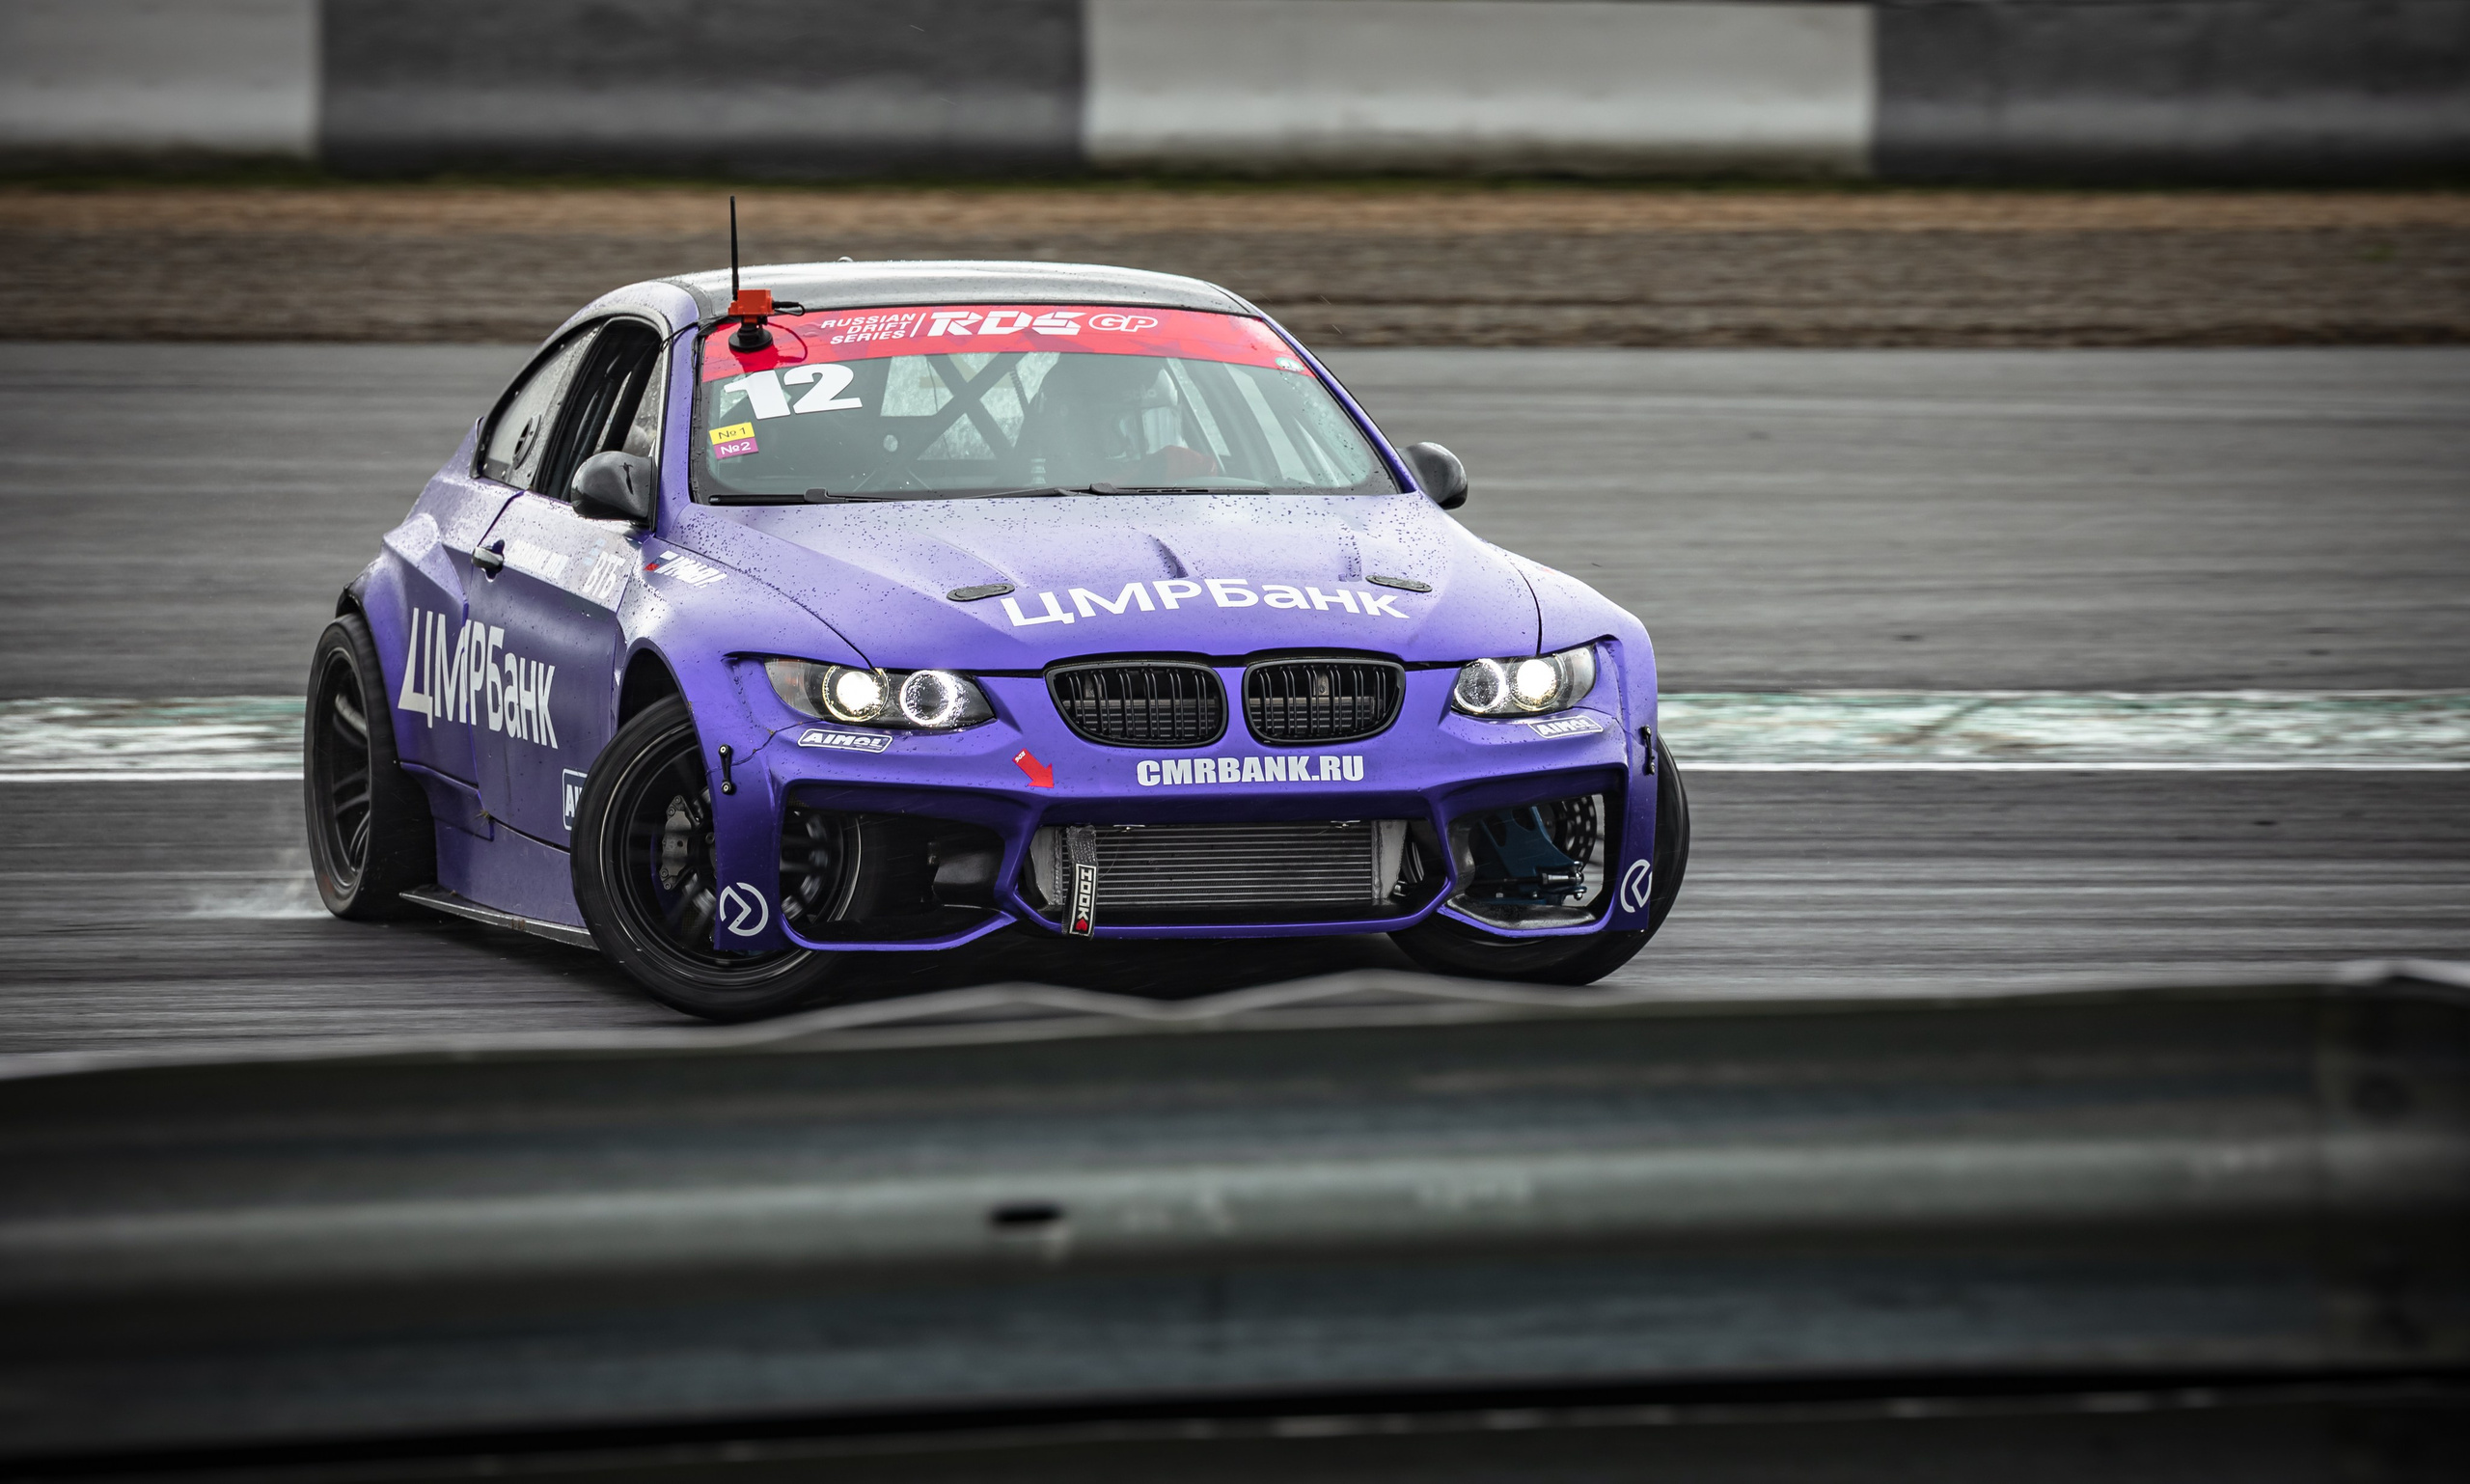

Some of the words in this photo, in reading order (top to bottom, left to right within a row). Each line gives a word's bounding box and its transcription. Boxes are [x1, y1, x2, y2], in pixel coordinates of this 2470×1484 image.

[821, 314, 917, 328] RUSSIAN
[847, 321, 912, 334] DRIFT
[927, 311, 1087, 336] RDS
[1088, 314, 1158, 332] GP
[830, 330, 906, 344] SERIES
[724, 364, 863, 419] 12
[1000, 579, 1410, 627] ЦМРБанк
[398, 607, 559, 749] ЦМРБанк
[1537, 719, 1595, 735] AIMOL
[802, 732, 883, 748] AIMOL
[1137, 756, 1364, 786] CMRBANK.RU
